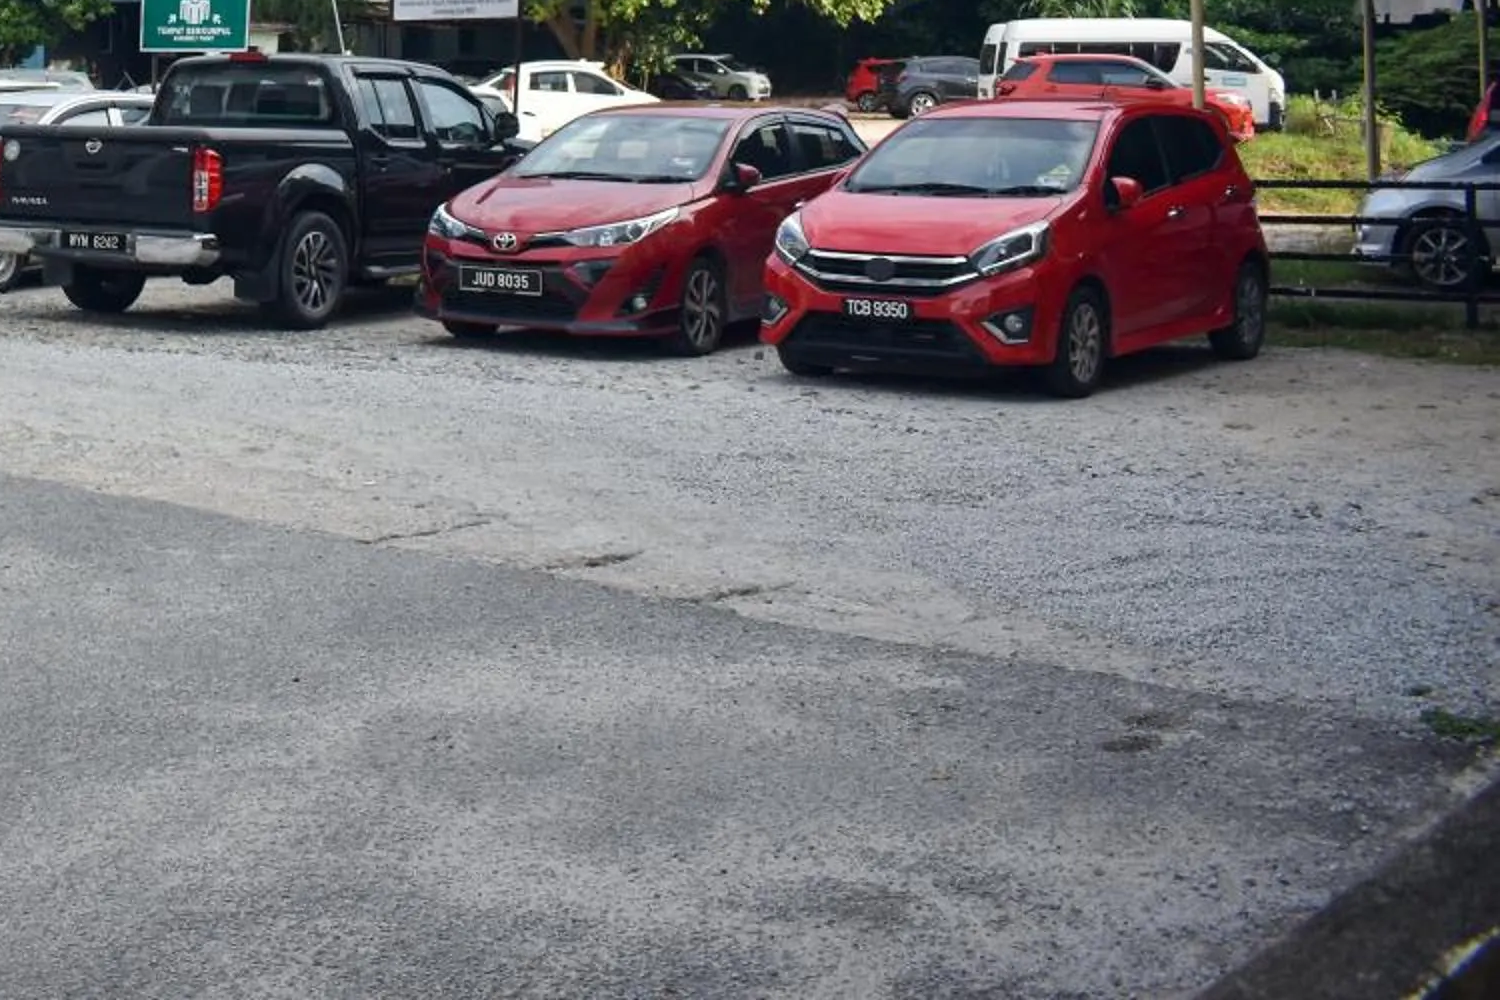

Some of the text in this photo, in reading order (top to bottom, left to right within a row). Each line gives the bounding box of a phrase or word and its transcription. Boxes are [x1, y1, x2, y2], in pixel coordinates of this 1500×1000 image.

[472, 271, 529, 289] JUD 8035
[846, 298, 871, 316] TCB
